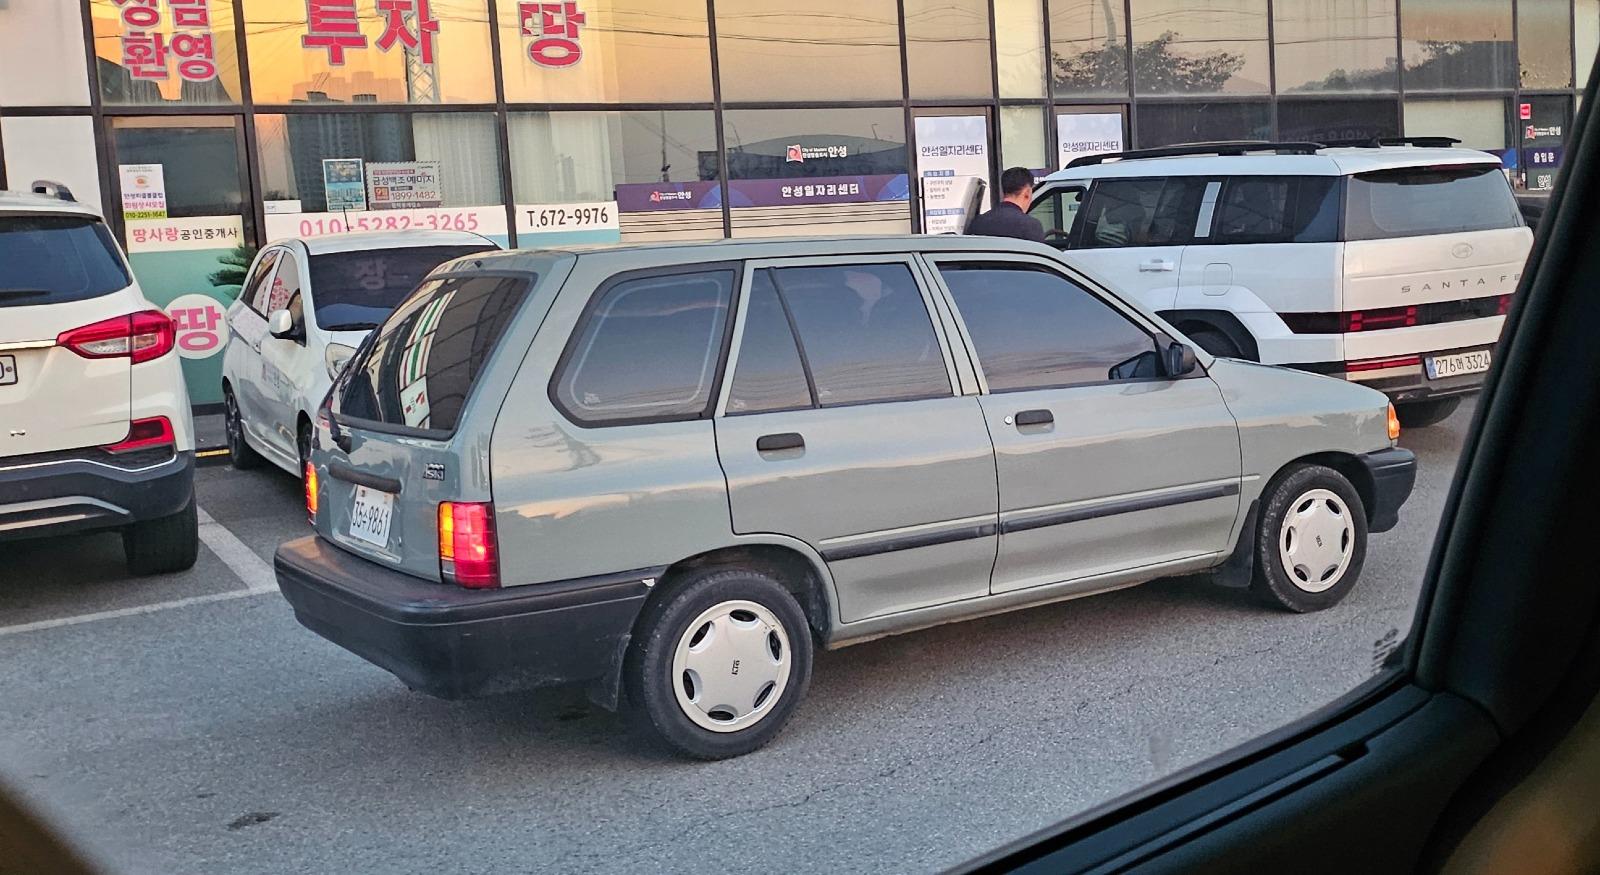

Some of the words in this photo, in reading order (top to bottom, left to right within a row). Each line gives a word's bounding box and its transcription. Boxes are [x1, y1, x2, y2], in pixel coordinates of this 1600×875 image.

[302, 0, 440, 65] 투자
[517, 1, 586, 69] 땅
[123, 31, 216, 80] 환영
[828, 145, 847, 158] 안성
[921, 144, 983, 157] 안성일자리센터
[1063, 141, 1119, 152] 안성일자리센터
[373, 176, 405, 186] 금성백조
[406, 175, 435, 184] 예미지
[781, 183, 859, 198] 안성일자리센터
[300, 212, 478, 237] 010-5282-3265
[526, 207, 609, 228] T.672-9976
[1401, 278, 1485, 293] SANTA
[171, 305, 221, 350] 땅
[352, 500, 389, 537] 35수9861
